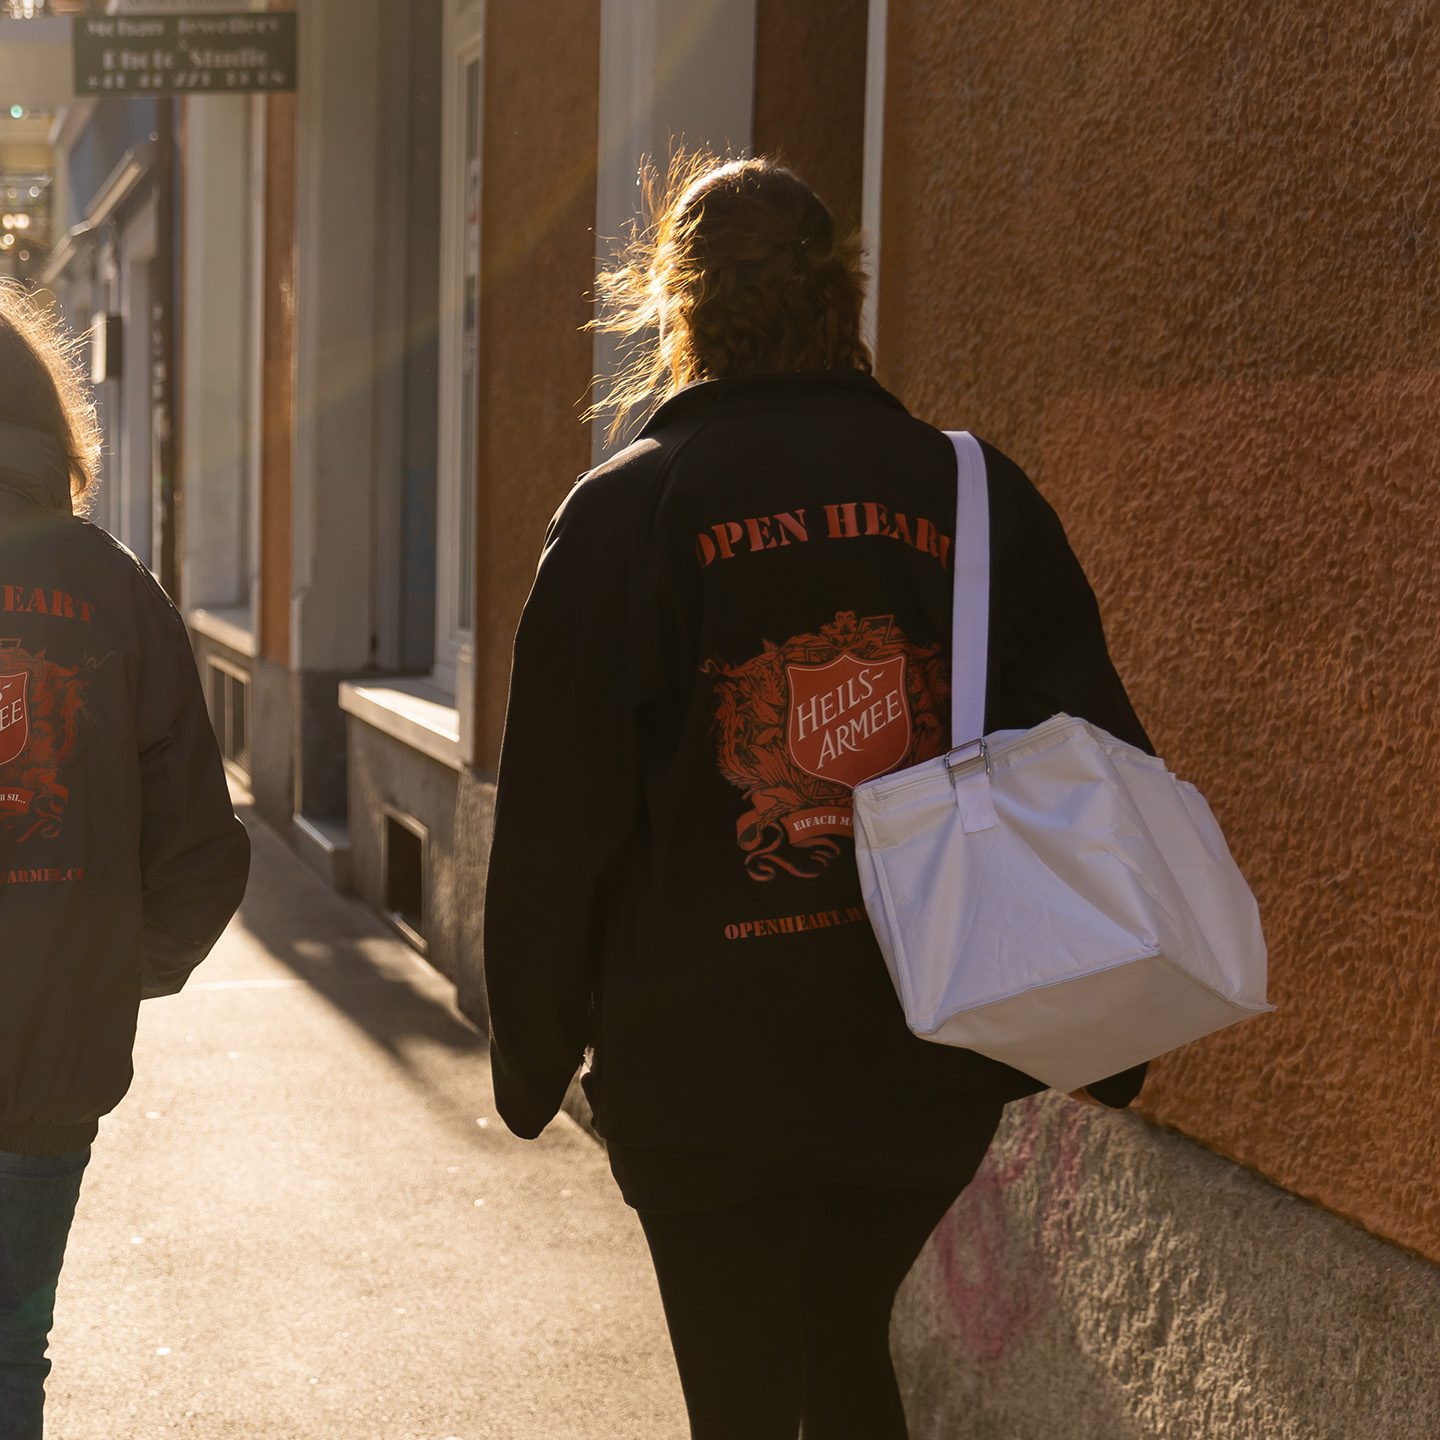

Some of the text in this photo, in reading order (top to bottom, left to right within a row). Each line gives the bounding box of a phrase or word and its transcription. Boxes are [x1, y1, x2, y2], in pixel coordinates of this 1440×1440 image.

[695, 508, 809, 569] OPEN
[796, 668, 885, 742] HEILS-
[816, 689, 902, 770] ARMEE
[793, 815, 836, 831] EIFACH
